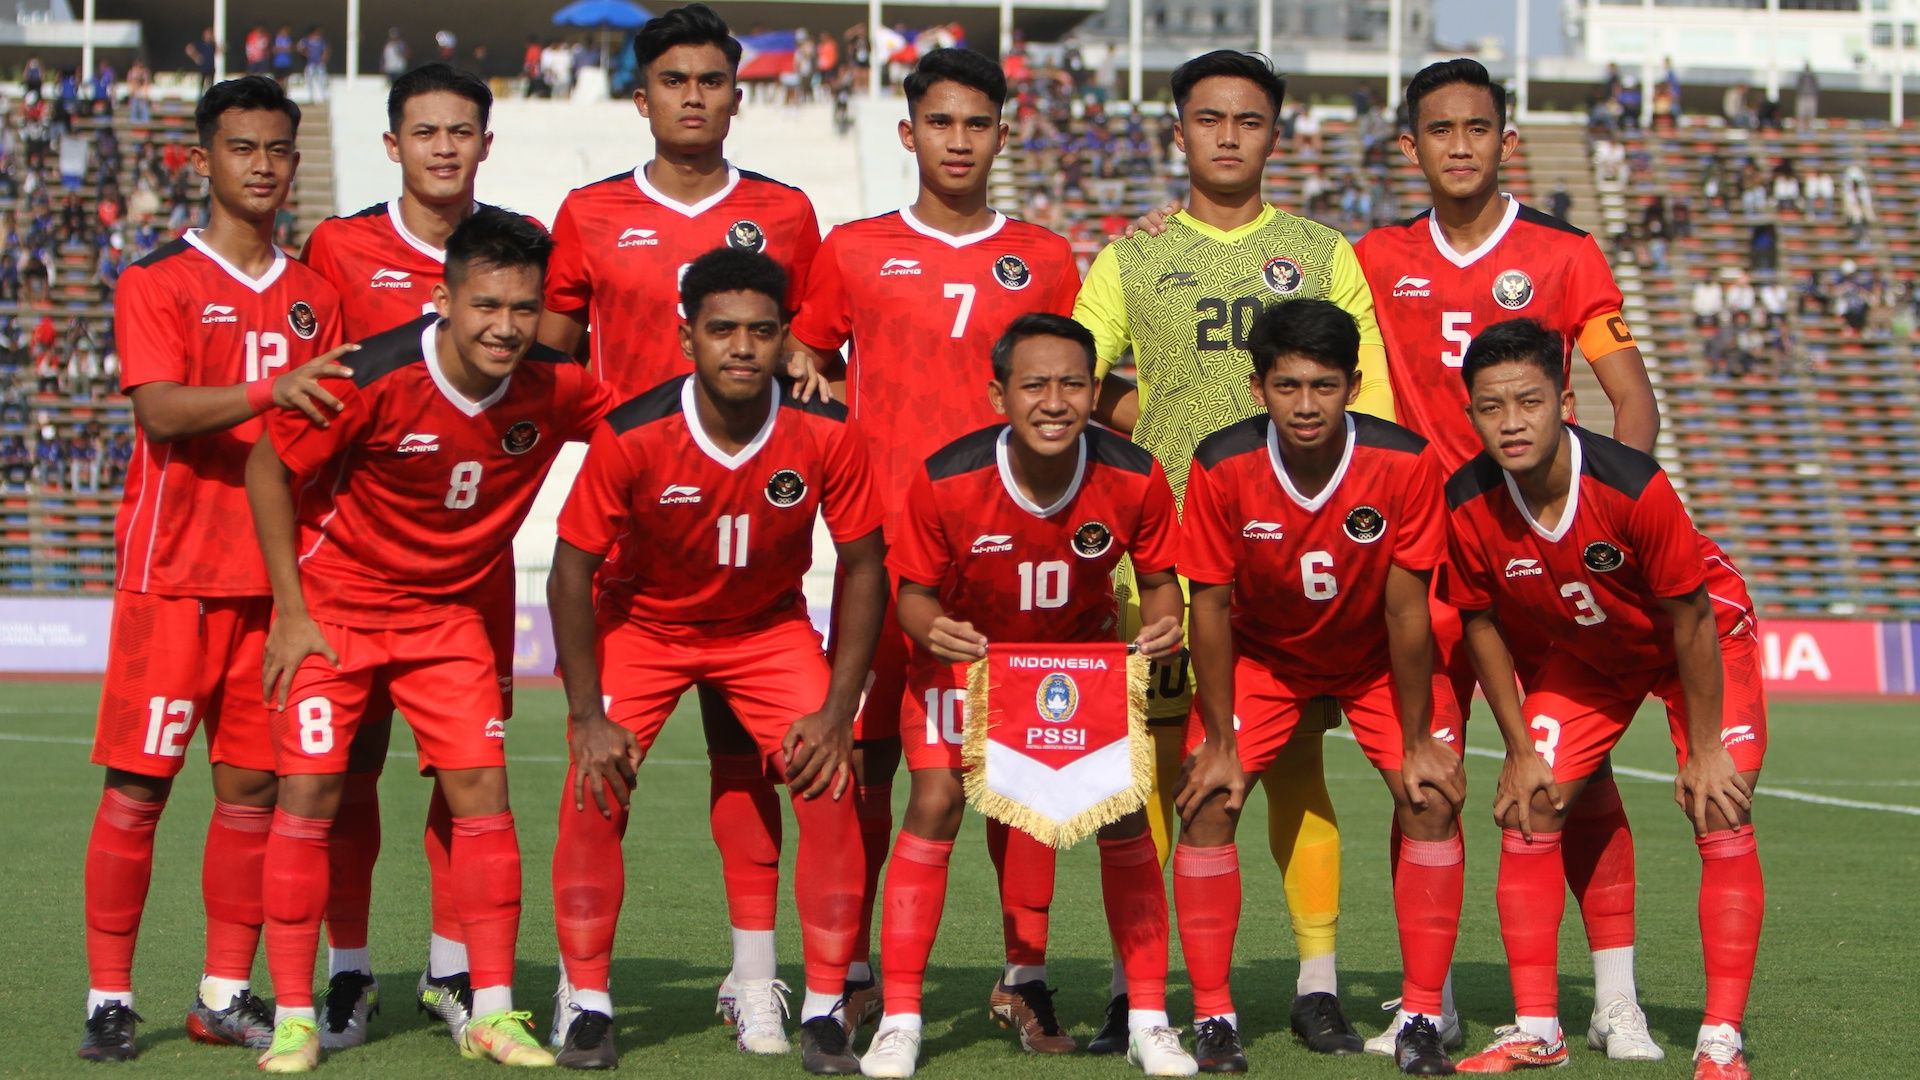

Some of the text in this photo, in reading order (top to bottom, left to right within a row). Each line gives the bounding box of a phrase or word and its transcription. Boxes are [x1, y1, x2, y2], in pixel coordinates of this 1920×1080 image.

[618, 239, 658, 247] LI-NING
[943, 283, 976, 338] 7
[1393, 289, 1430, 297] LI-NING
[202, 315, 237, 323] LI-NING
[1196, 297, 1266, 350] 20
[1441, 312, 1472, 368] 5
[1606, 316, 1632, 343] C
[245, 331, 287, 382] 12
[397, 444, 440, 452] LI-NING
[444, 461, 483, 509] 8
[659, 496, 701, 504] LI-NING
[717, 514, 749, 567] 11
[971, 544, 1012, 553] LI-NING
[1243, 530, 1283, 540] LI-NING
[1018, 560, 1069, 611] 10
[1300, 551, 1338, 600] 6
[1505, 567, 1543, 578] LI-NING
[1560, 582, 1607, 626] 3
[1009, 656, 1107, 669] INDONESIA
[1762, 632, 1831, 680] IA
[144, 697, 194, 756] 12
[298, 697, 334, 754] 8
[924, 687, 967, 745] 10
[1026, 728, 1085, 745] PSSI
[1530, 714, 1560, 769] 3
[1724, 733, 1755, 749] I-NING
